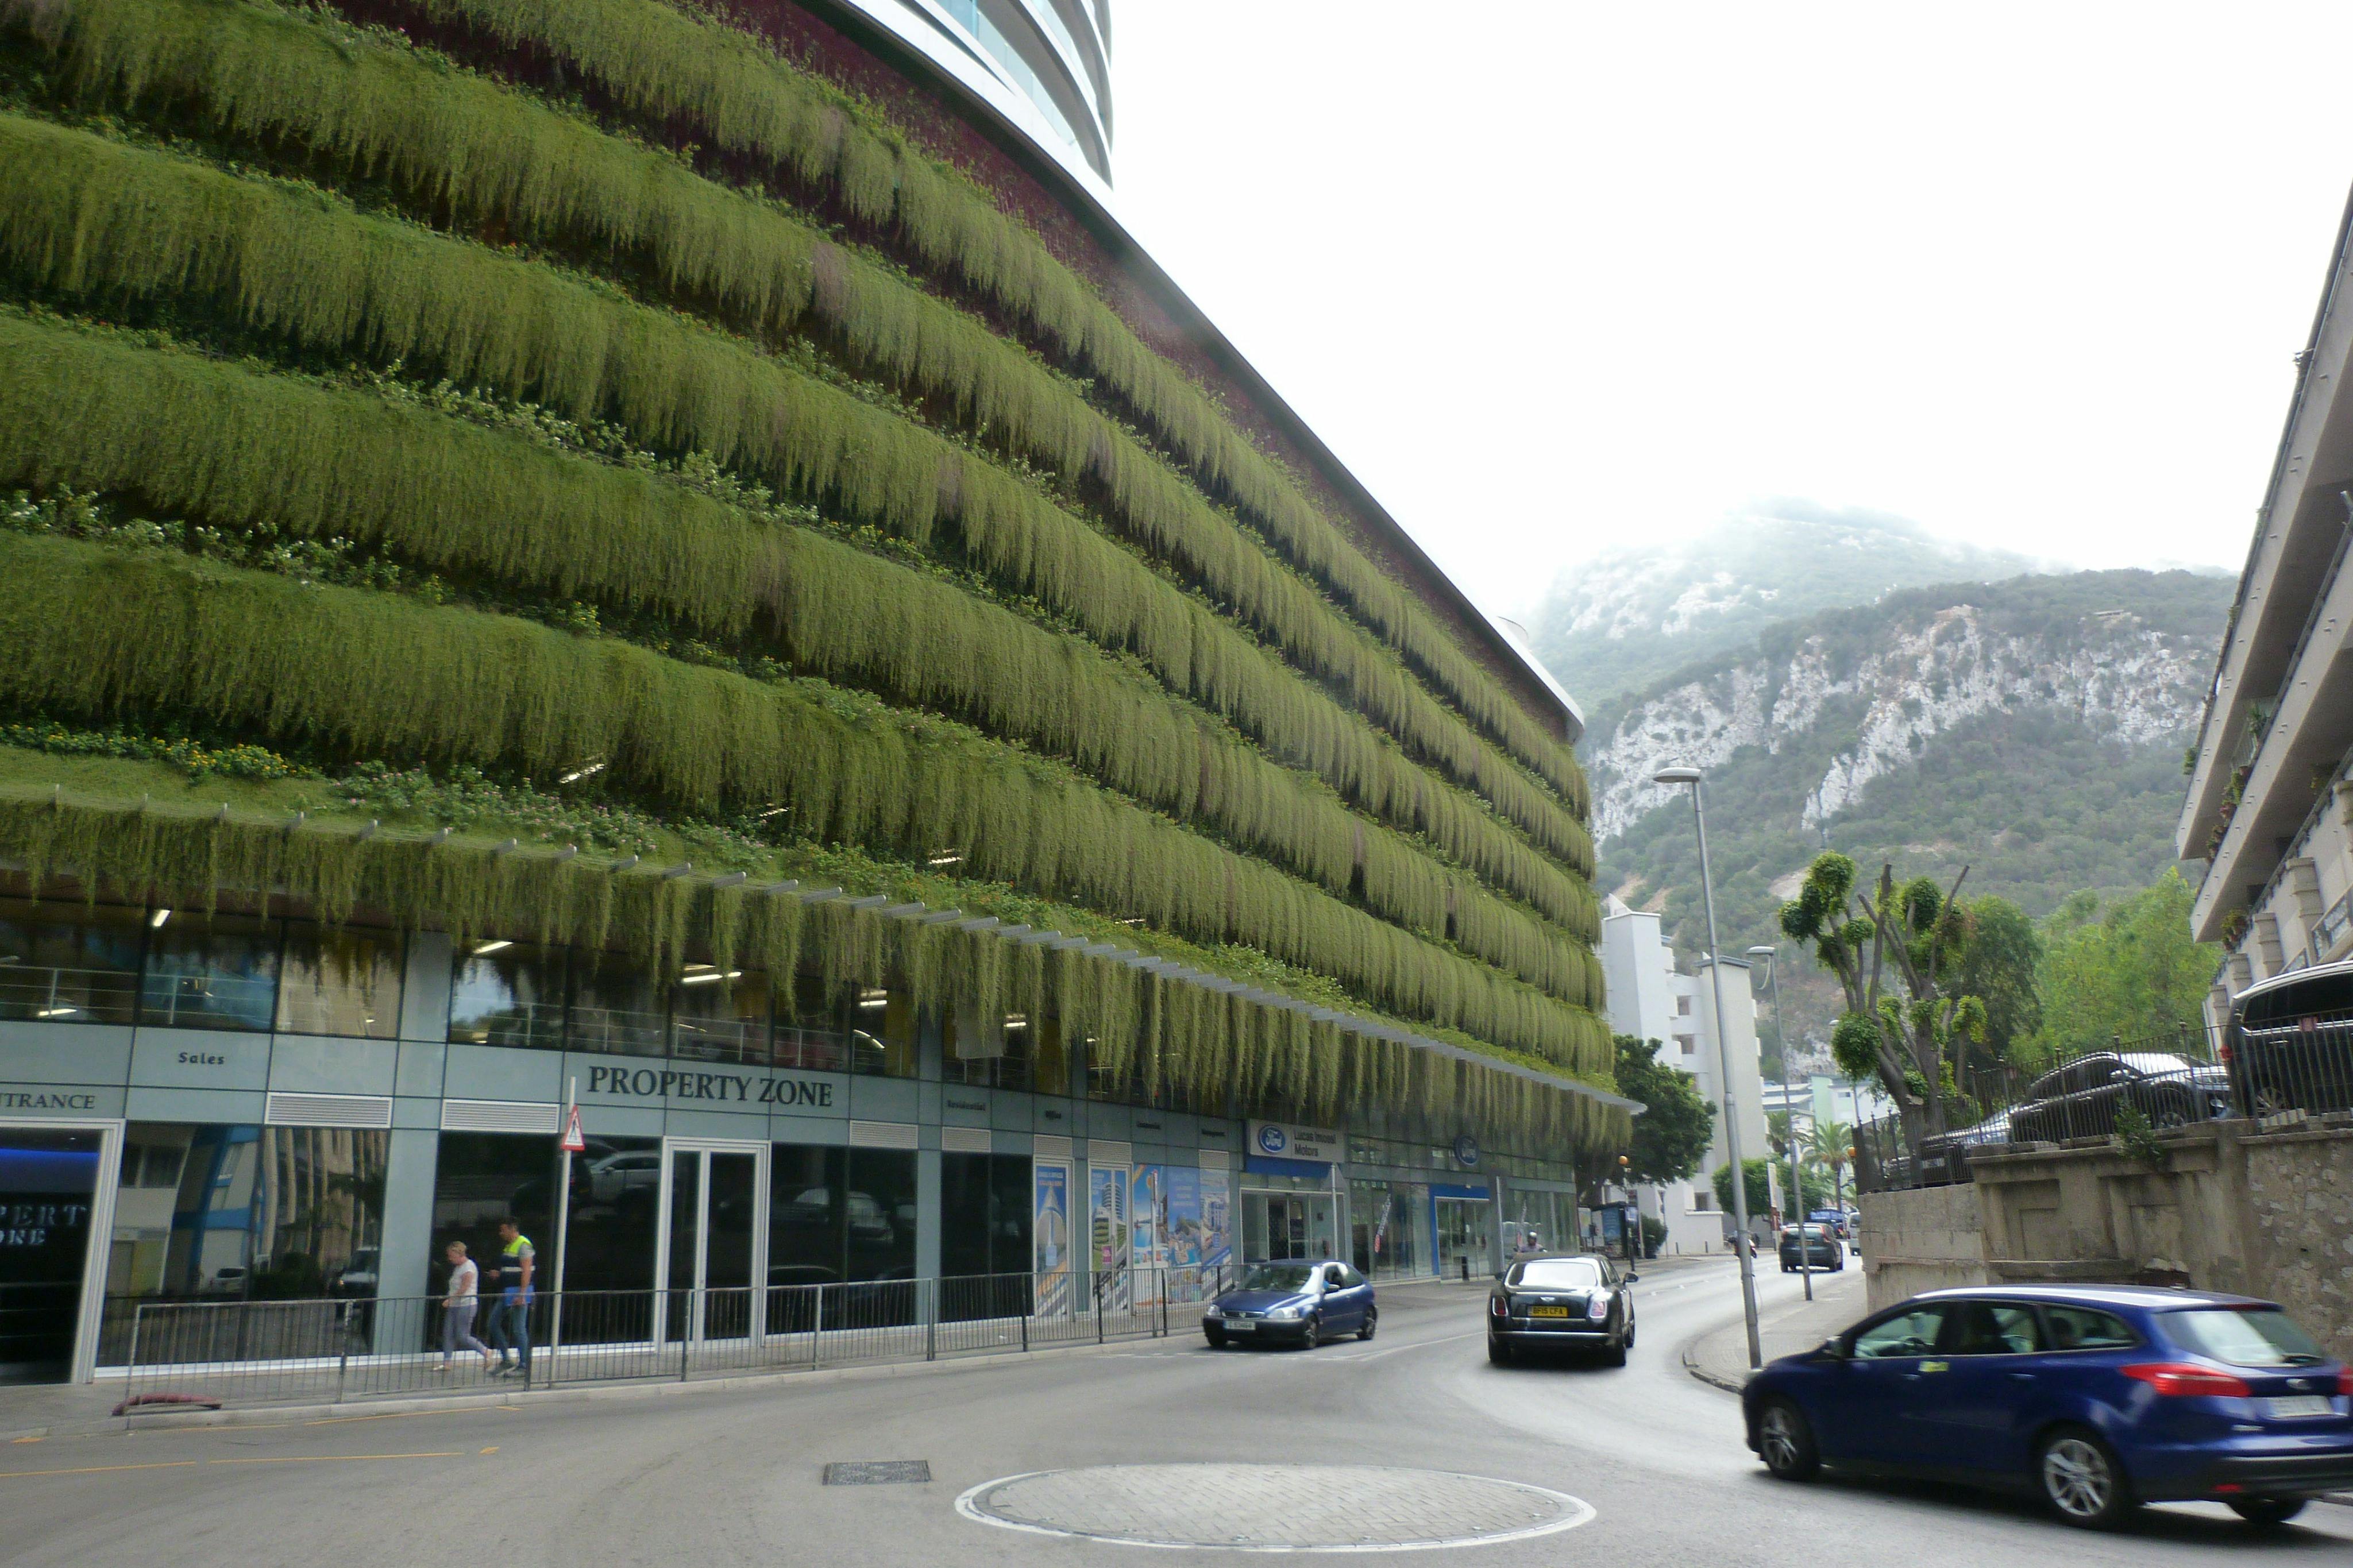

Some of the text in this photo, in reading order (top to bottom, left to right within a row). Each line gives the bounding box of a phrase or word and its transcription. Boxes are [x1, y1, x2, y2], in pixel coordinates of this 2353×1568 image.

[178, 1052, 225, 1065] Sales
[588, 1065, 833, 1107] PROPERTY ZONE
[0, 1092, 95, 1110] TRANCE
